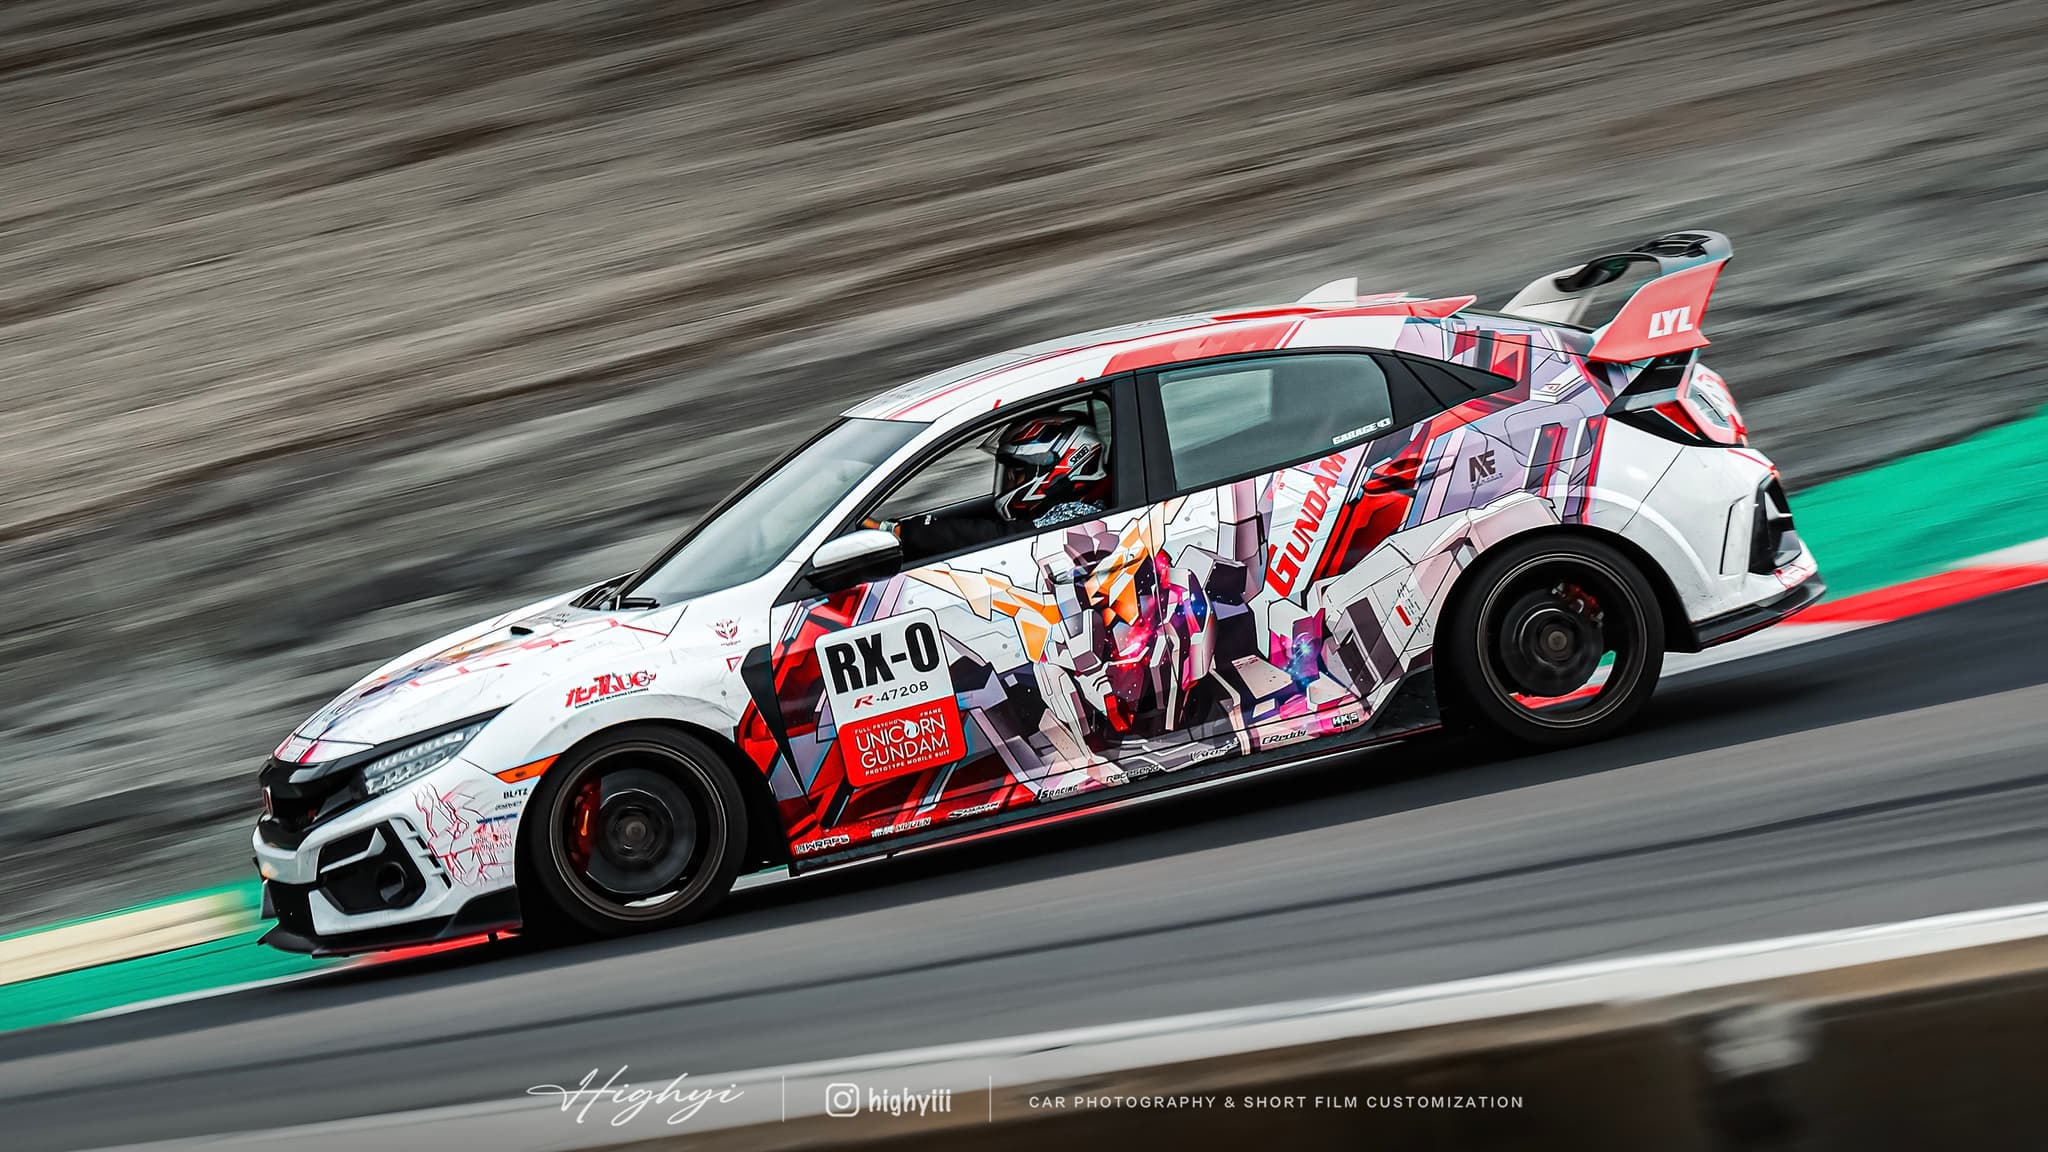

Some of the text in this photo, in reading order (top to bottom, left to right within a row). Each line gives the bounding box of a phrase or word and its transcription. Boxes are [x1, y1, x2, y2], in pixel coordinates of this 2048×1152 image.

[1648, 305, 1694, 339] LYL
[1332, 422, 1378, 445] GARAGE
[1265, 452, 1347, 599] GUNDAM
[854, 707, 942, 735] FULL PSYCHO FRAME
[855, 713, 946, 752] UNICORN
[1332, 712, 1359, 727] HKS
[861, 731, 949, 769] GUNDAM
[865, 749, 950, 777] PROTOTYPE MOBILE SUIT
